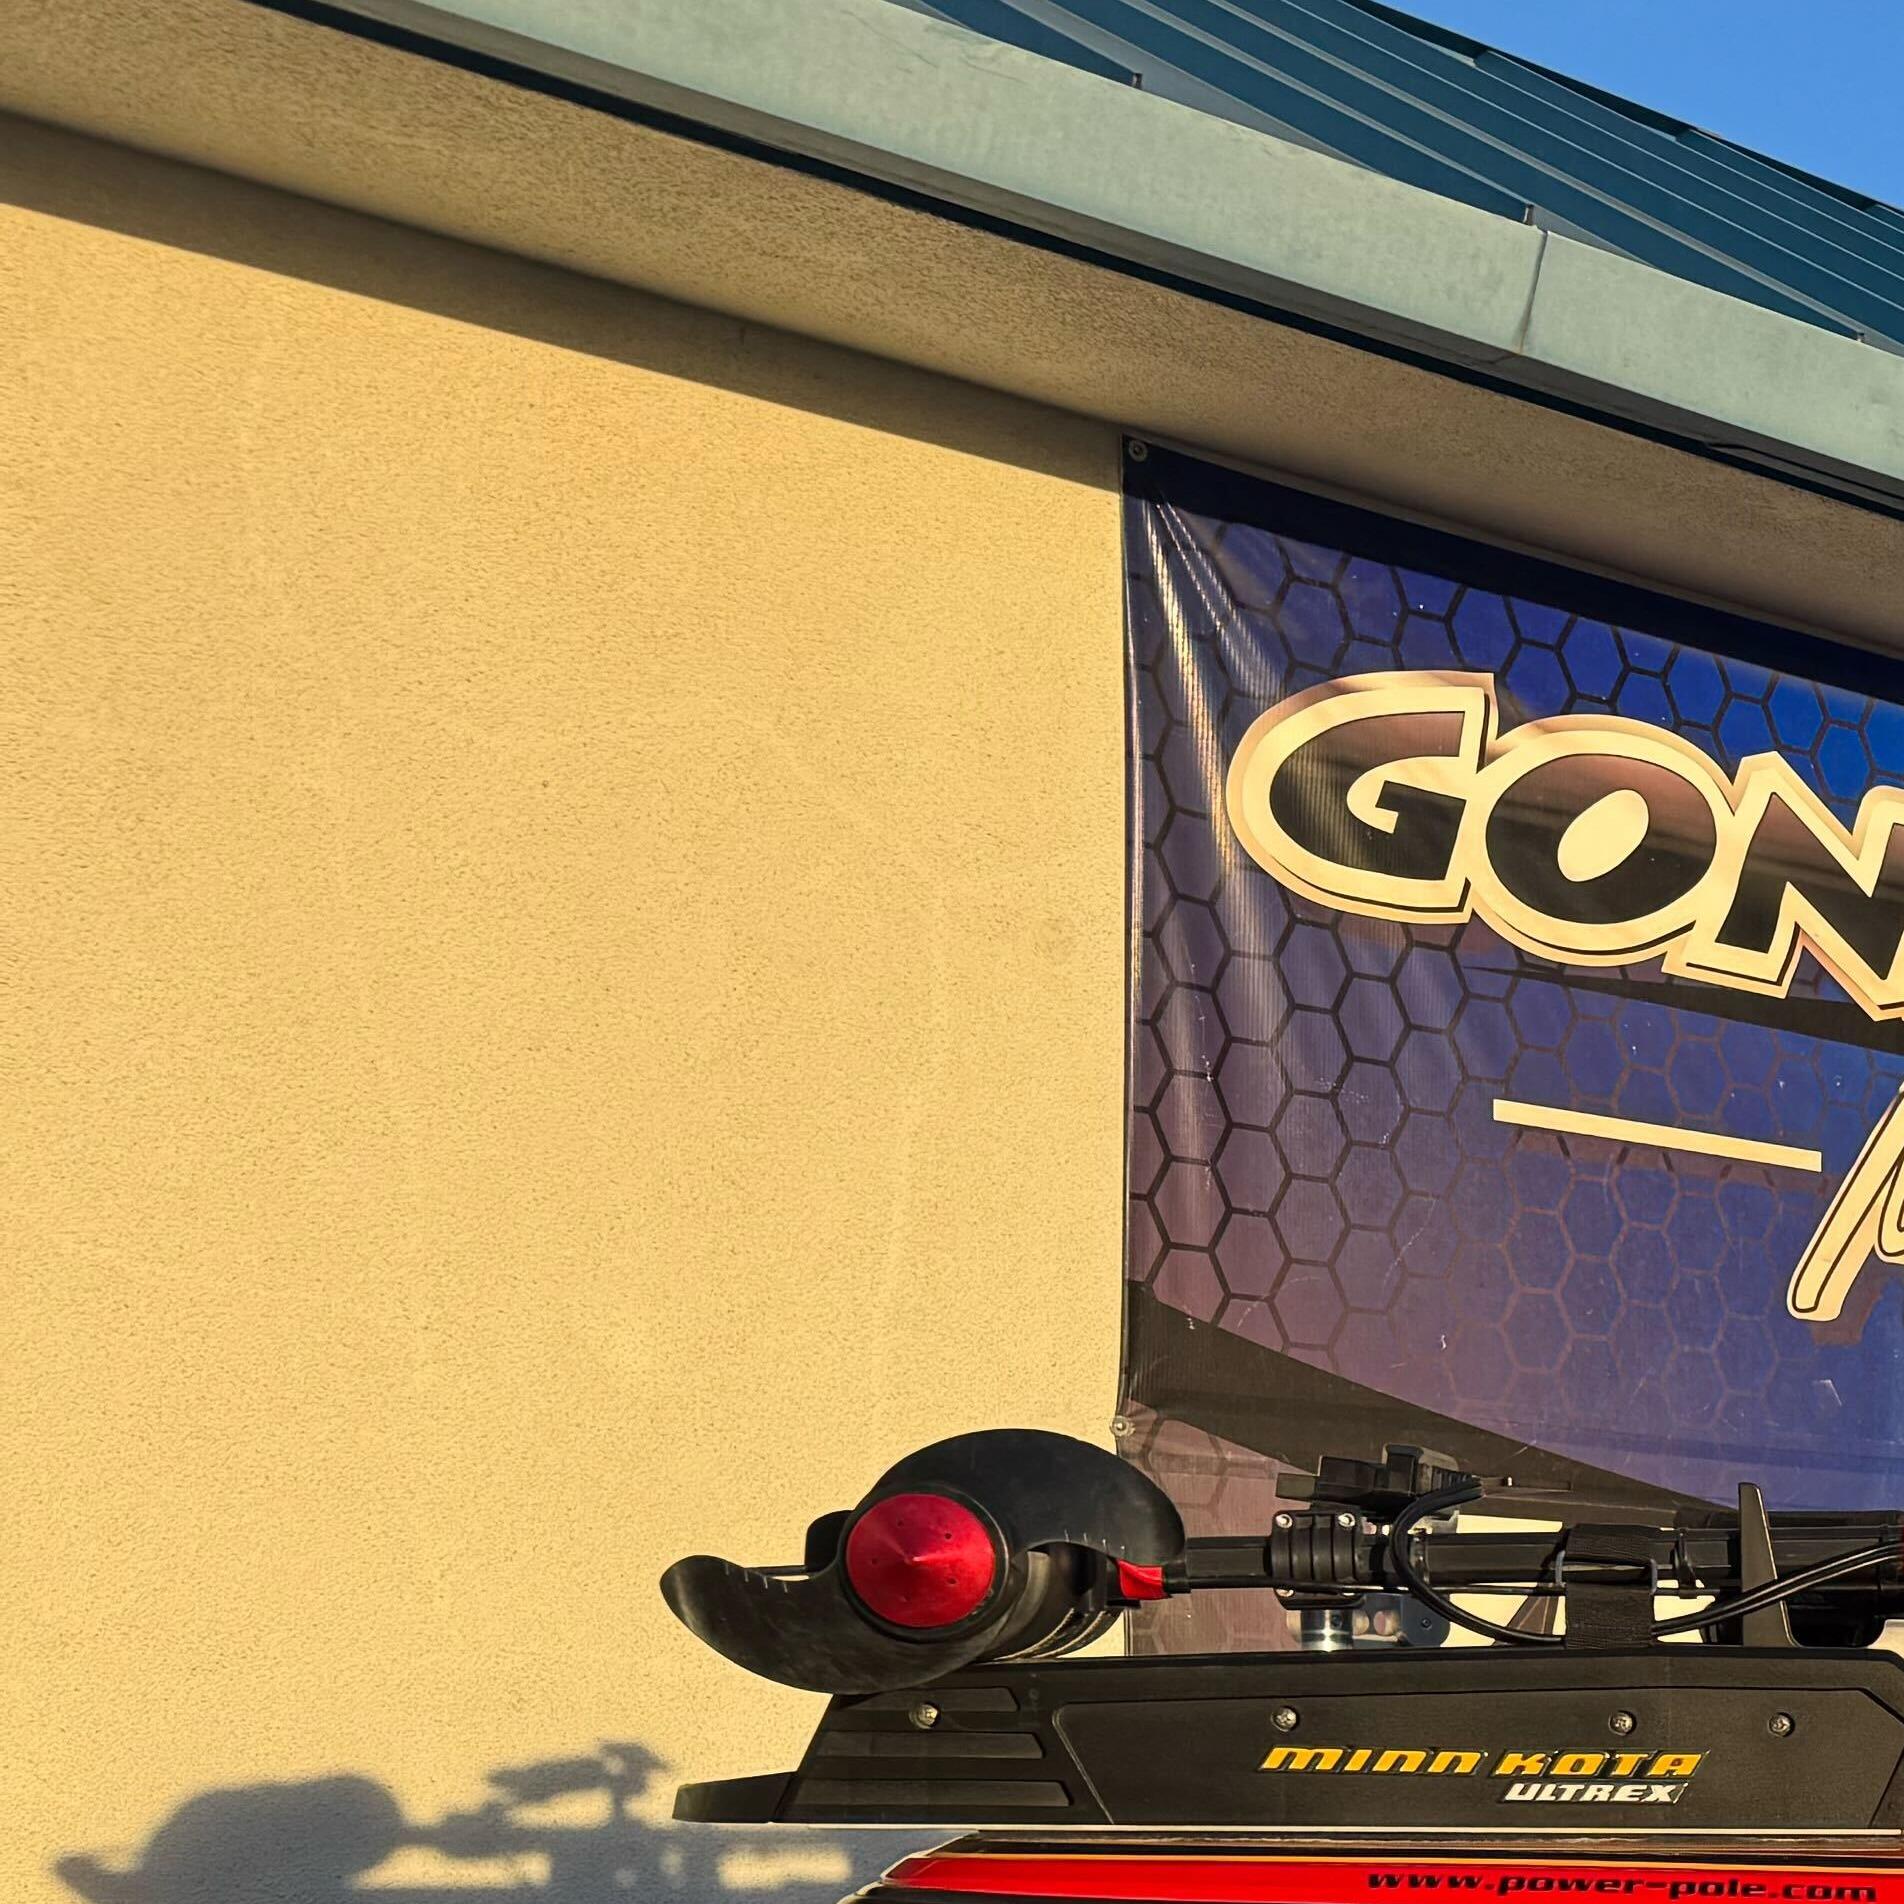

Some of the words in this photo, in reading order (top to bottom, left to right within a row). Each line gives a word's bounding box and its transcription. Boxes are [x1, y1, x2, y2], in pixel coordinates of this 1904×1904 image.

[1259, 1746, 1487, 1775] MINN
[1494, 1751, 1706, 1778] KOTA
[1505, 1781, 1687, 1804] ULTREX
[1368, 1872, 1877, 1903] www.power-pole.com
